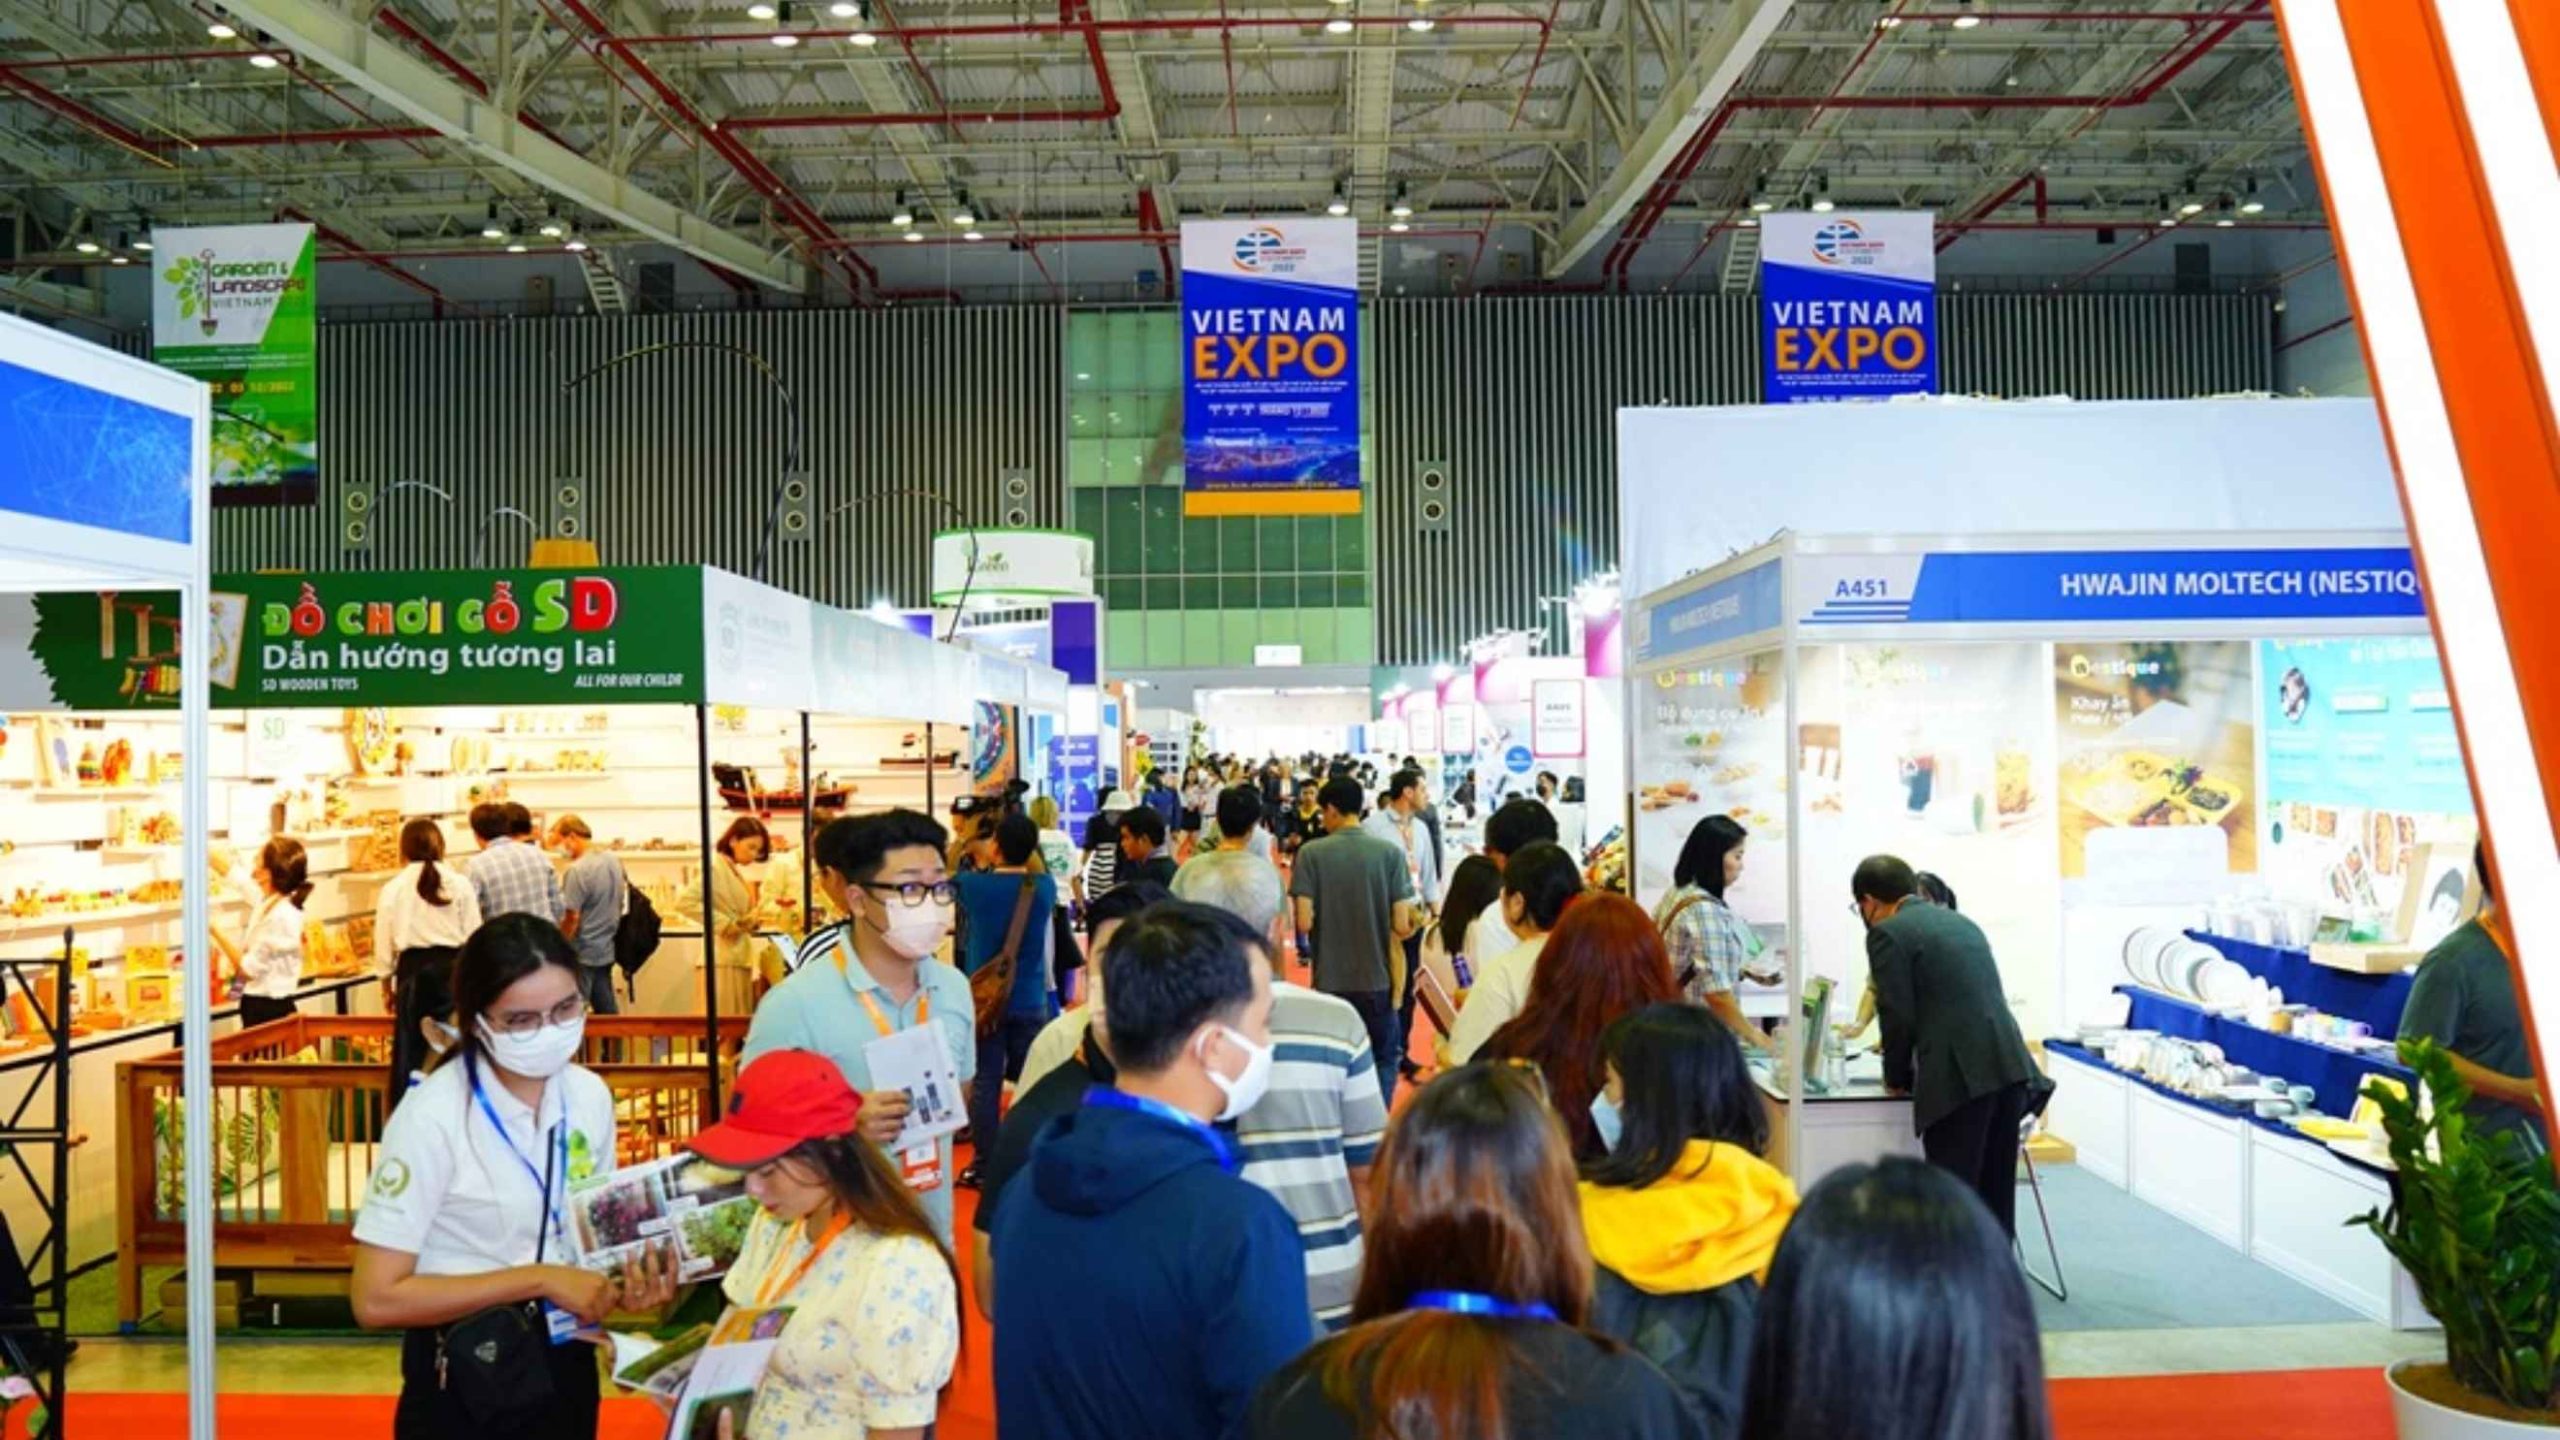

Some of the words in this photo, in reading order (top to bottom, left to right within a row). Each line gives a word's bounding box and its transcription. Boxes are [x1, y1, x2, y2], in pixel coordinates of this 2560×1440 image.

[211, 263, 277, 277] GARDEN
[211, 279, 304, 293] LANDSCAPE
[1191, 307, 1345, 334] VIETNAM
[1772, 301, 1924, 325] VIETNAM
[1194, 333, 1347, 380] EXPO
[1775, 326, 1926, 371] EXPO
[1835, 579, 1887, 597] A451
[2060, 572, 2167, 596] HWAJIN
[2175, 570, 2302, 596] MOLTECH
[2309, 569, 2423, 597] (NESTIQ
[262, 581, 326, 638] ĐỒ
[337, 596, 443, 636] CHƠI
[457, 581, 521, 635] GỖ
[532, 576, 618, 633] SD
[262, 640, 329, 670] Dẫn
[339, 642, 449, 675] hướng
[459, 643, 564, 674] tương
[574, 639, 616, 666] lai
[279, 678, 328, 690] WOODEN
[331, 677, 359, 690] TOYS
